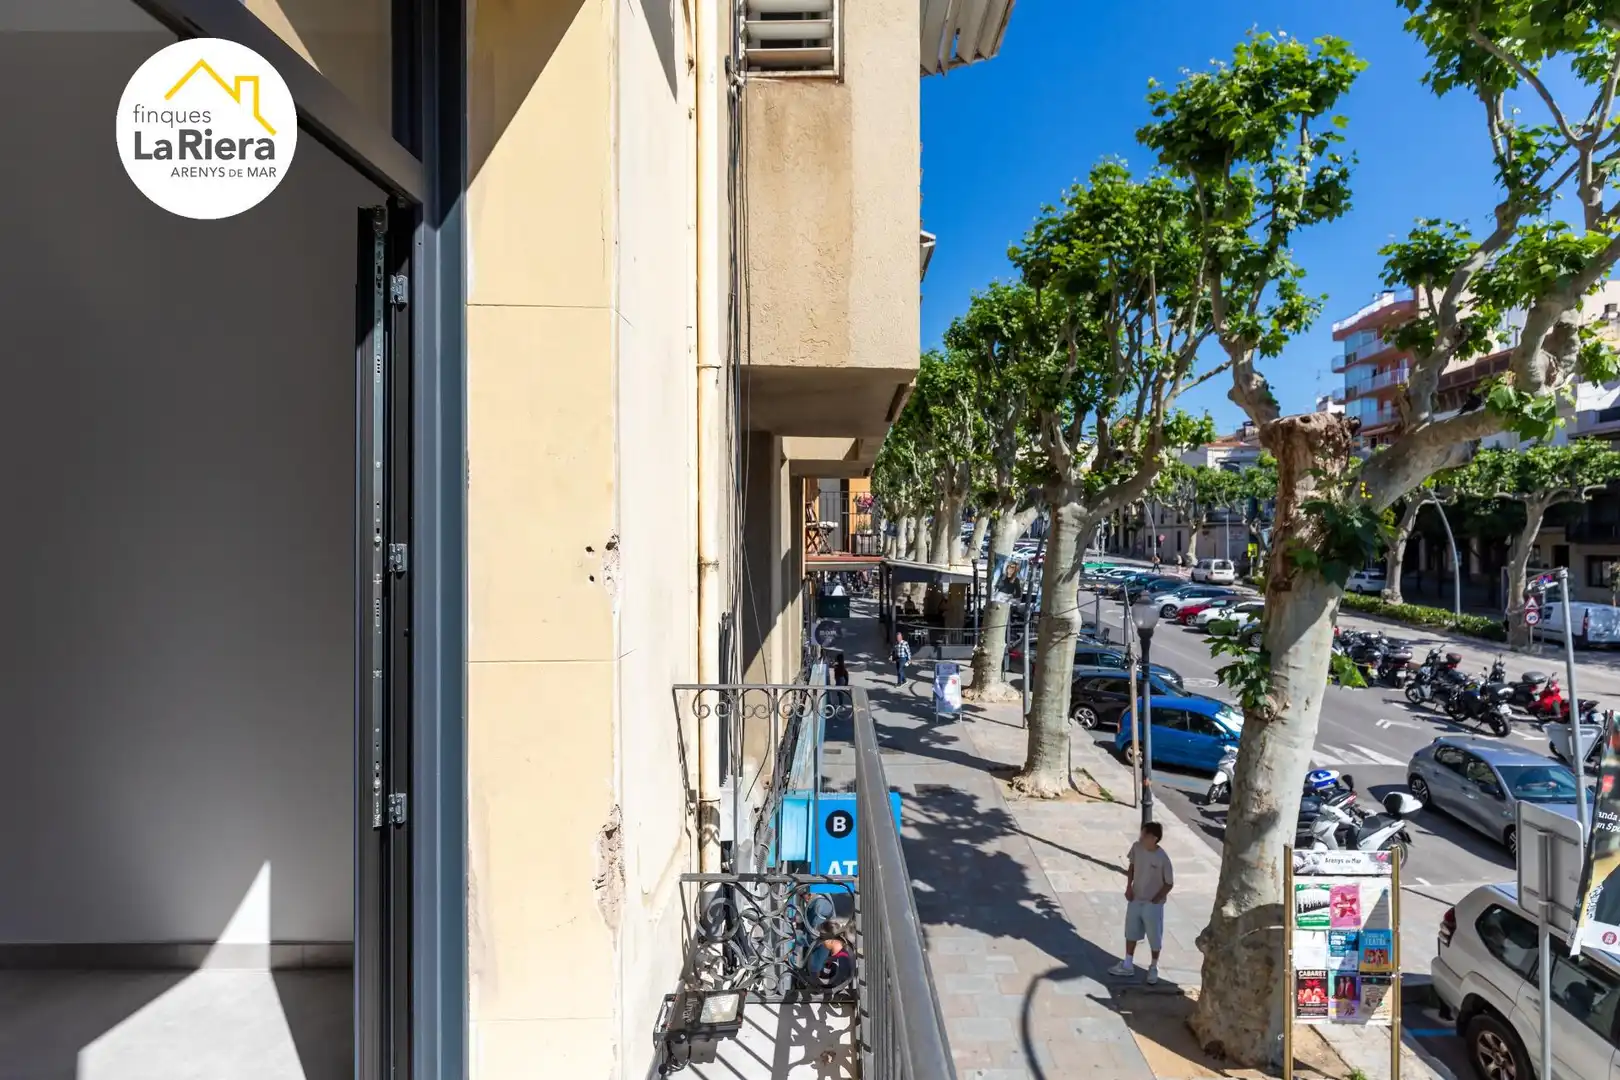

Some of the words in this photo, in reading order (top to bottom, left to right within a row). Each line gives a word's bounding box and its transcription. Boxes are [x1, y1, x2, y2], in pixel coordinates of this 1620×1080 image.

[833, 816, 847, 832] B
[1606, 823, 1620, 833] Spo
[827, 860, 858, 876] AT
